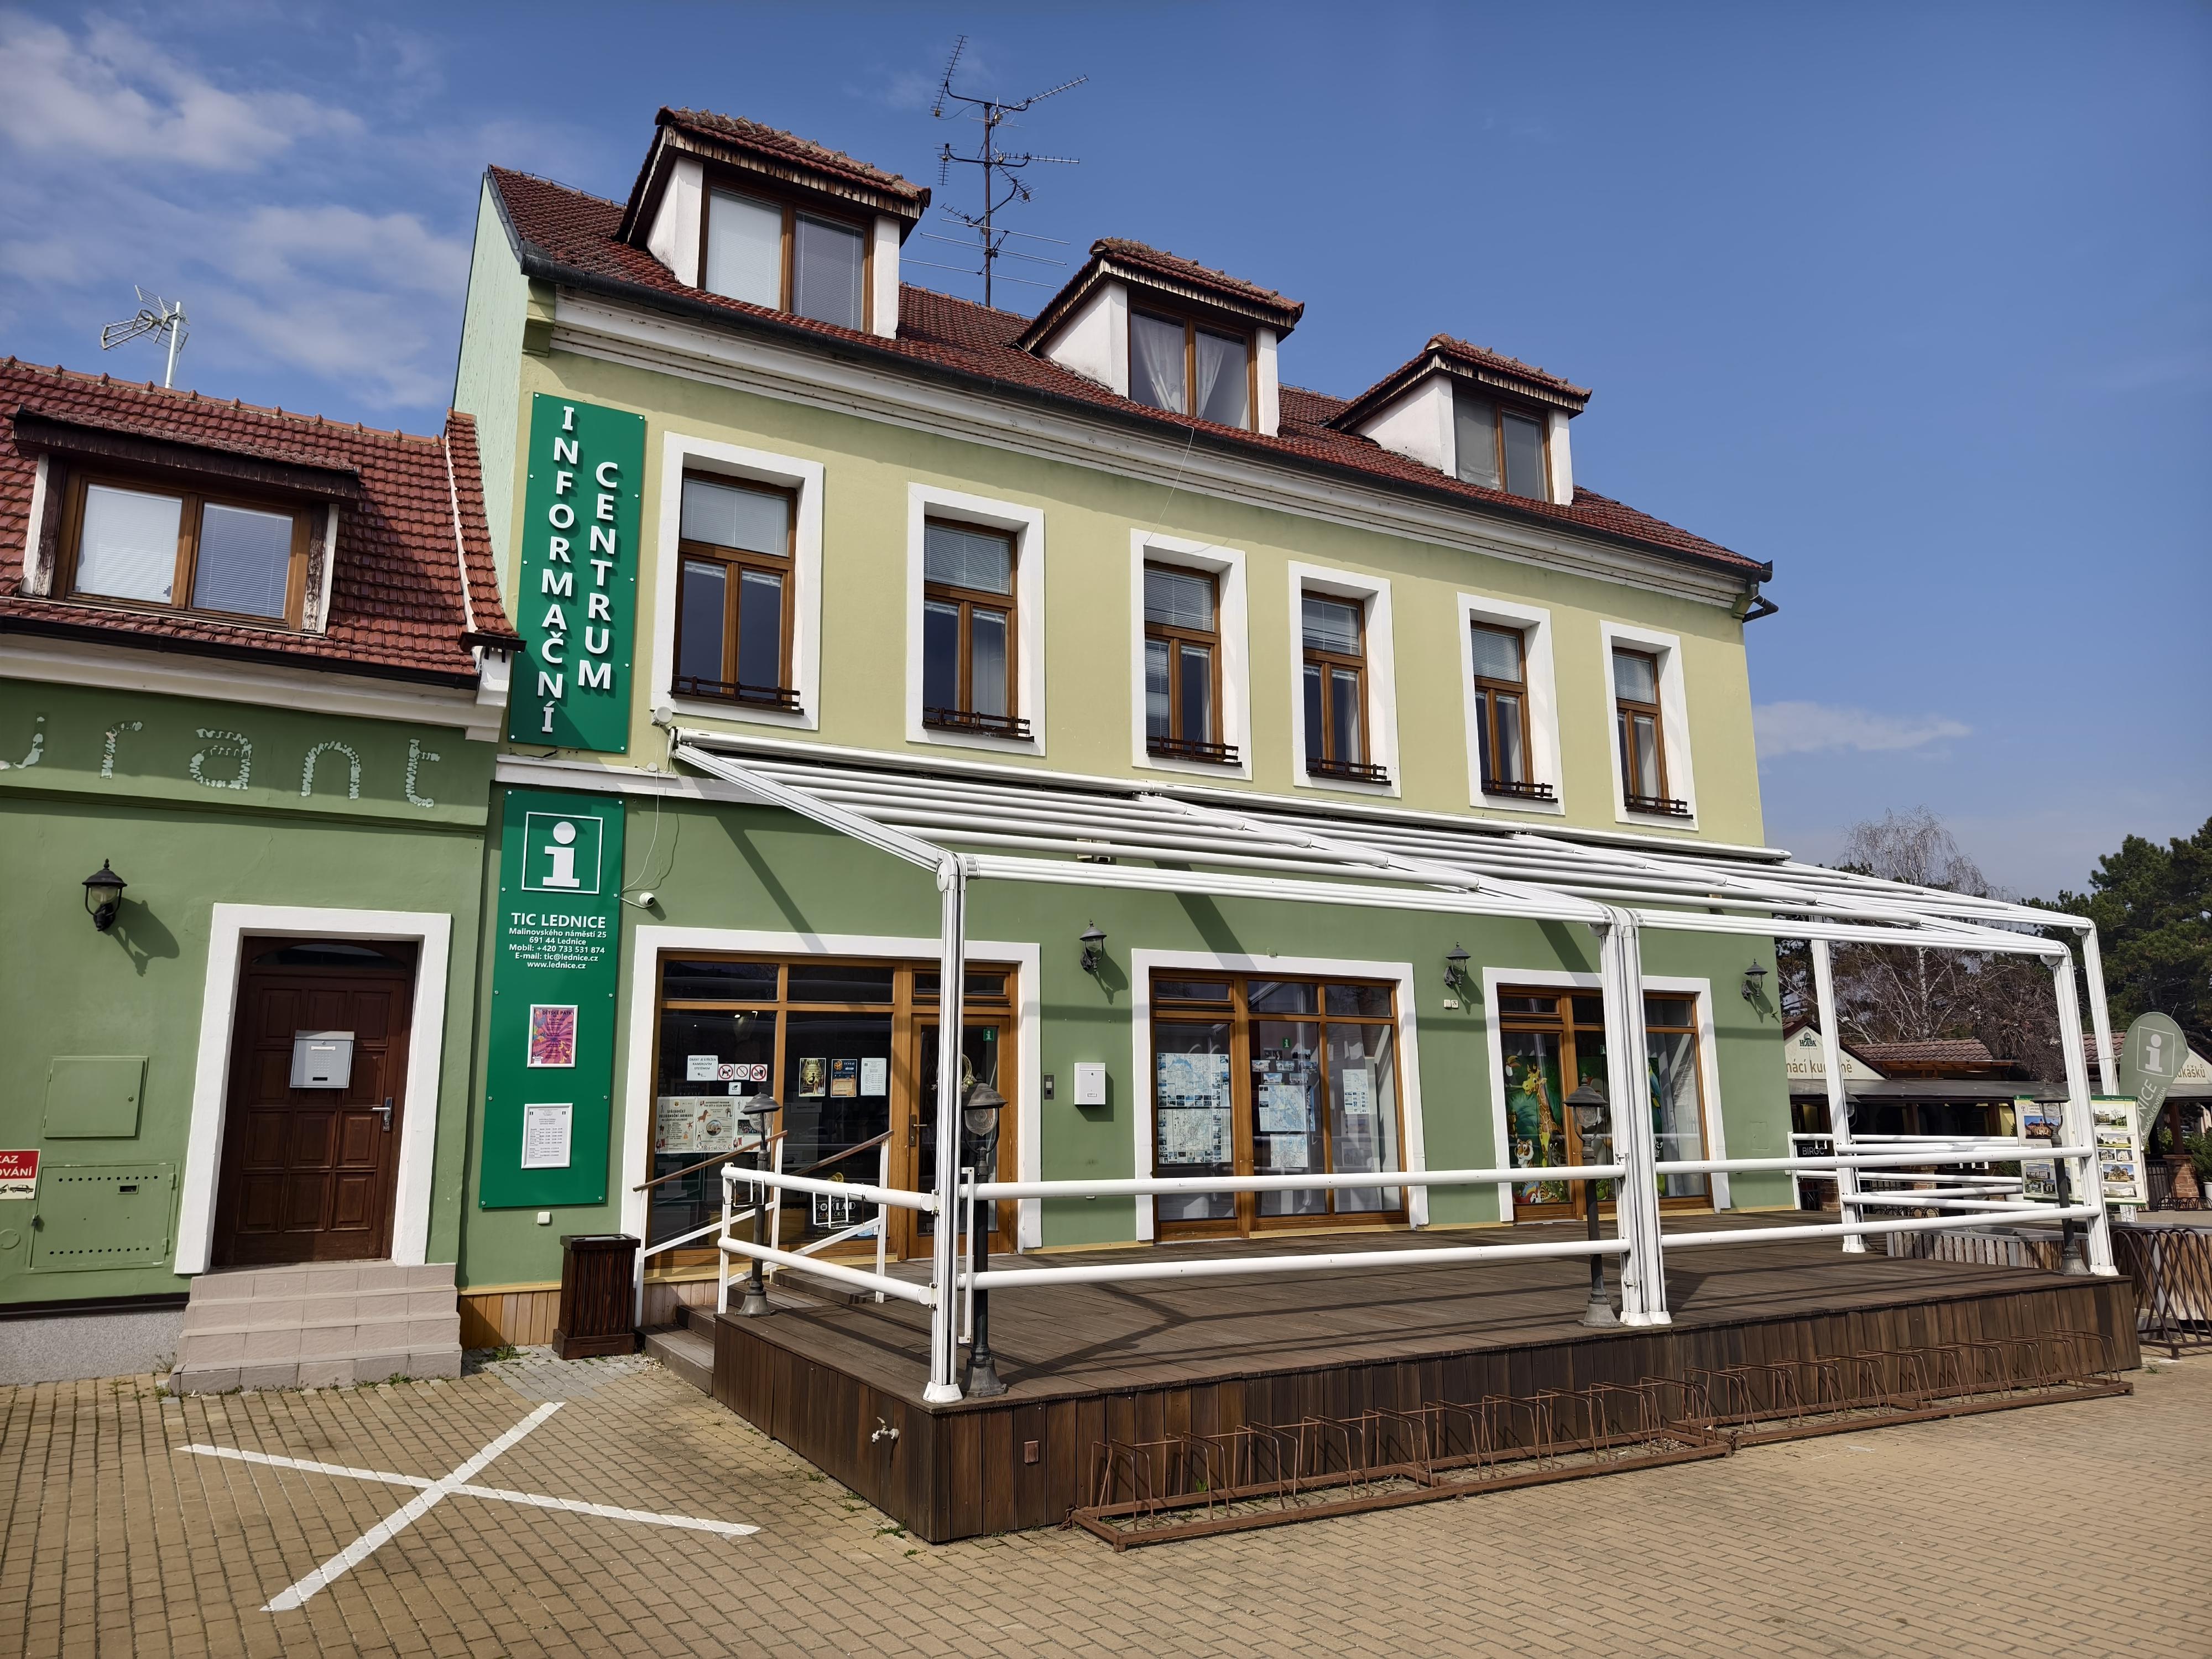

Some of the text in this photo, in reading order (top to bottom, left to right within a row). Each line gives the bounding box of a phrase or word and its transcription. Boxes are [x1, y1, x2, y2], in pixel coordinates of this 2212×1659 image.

[538, 405, 578, 733] INFORMAČNÍ
[578, 461, 618, 690] CENTRUM
[509, 928, 564, 936] Malinovského
[511, 912, 606, 928] TIC LEDNICE
